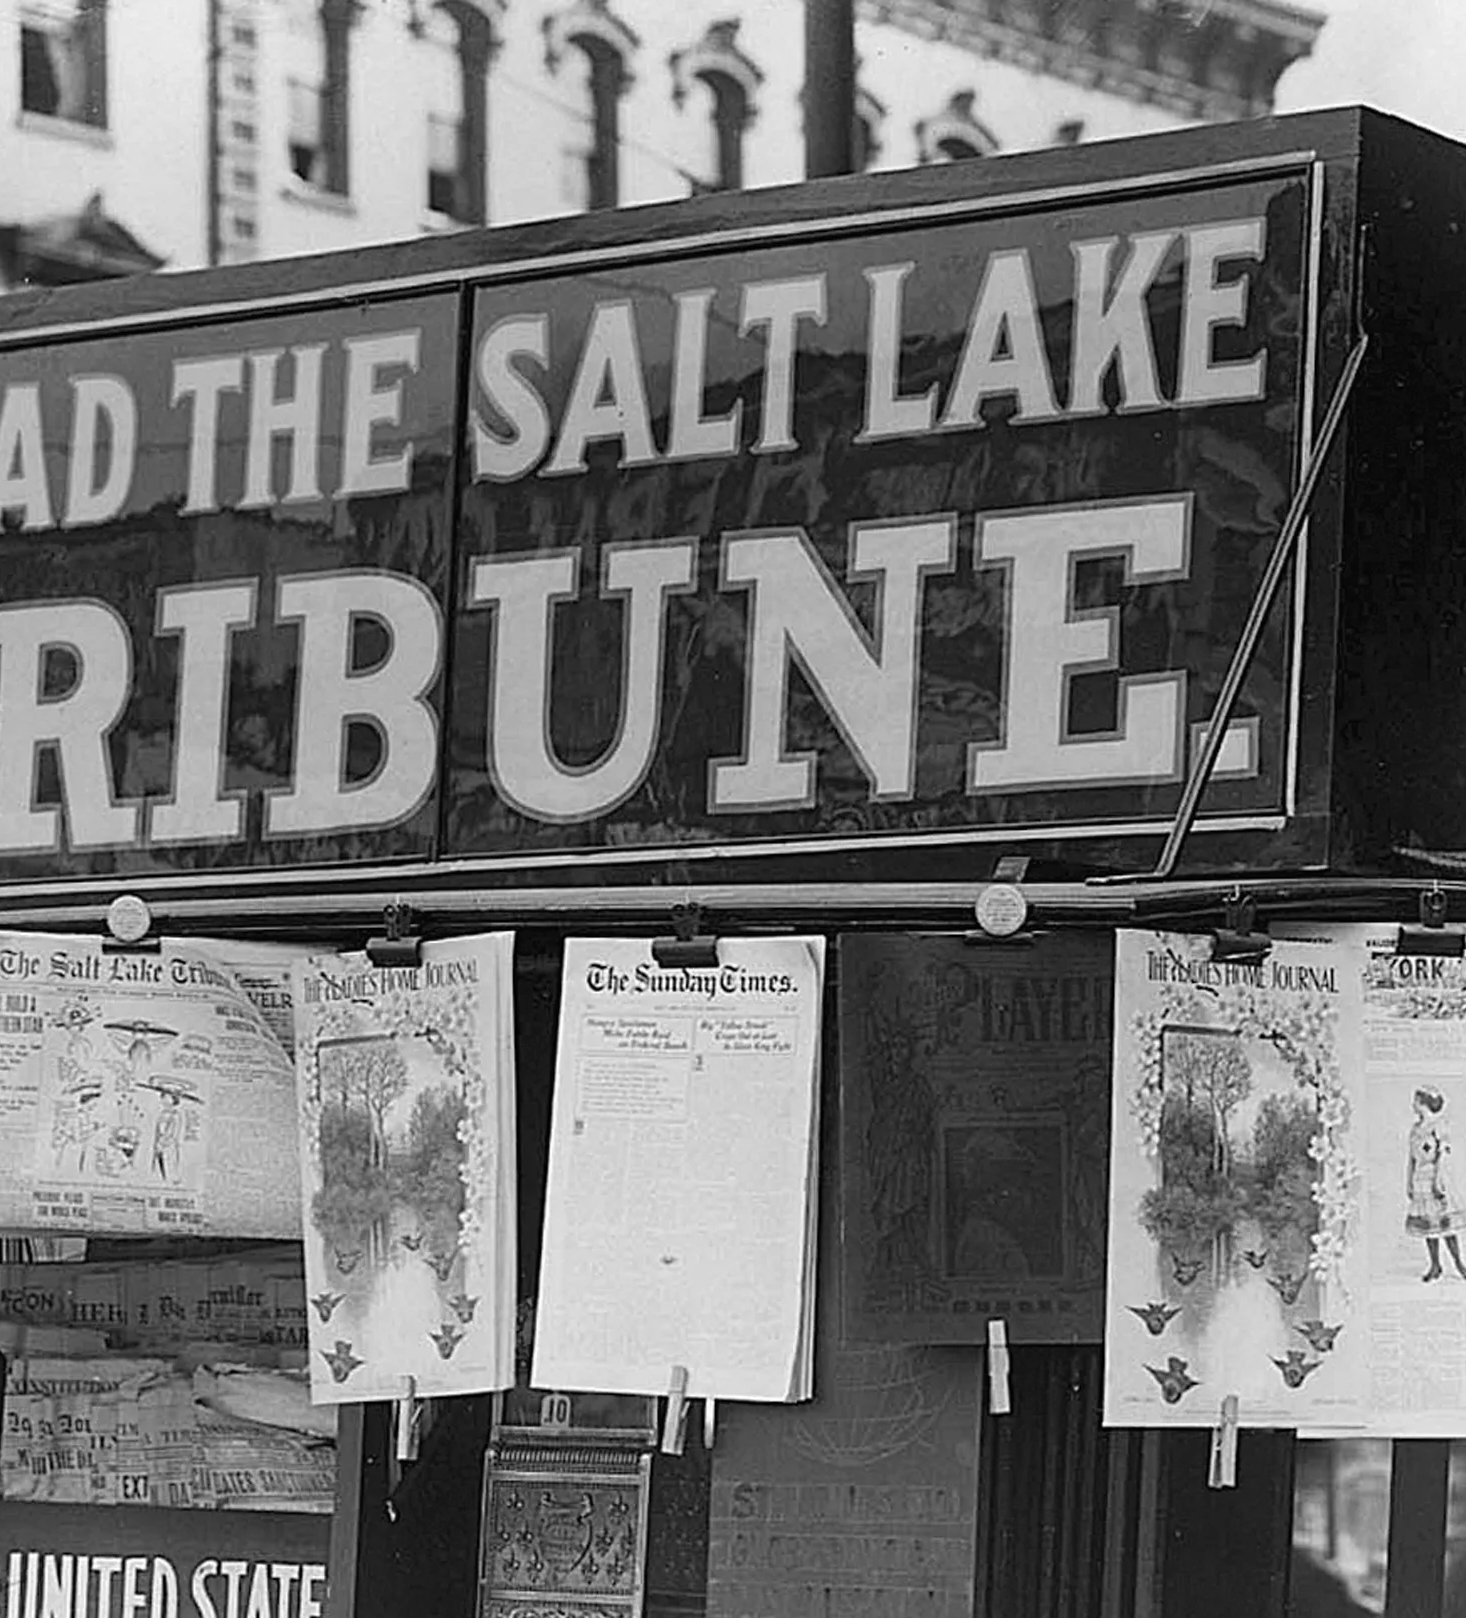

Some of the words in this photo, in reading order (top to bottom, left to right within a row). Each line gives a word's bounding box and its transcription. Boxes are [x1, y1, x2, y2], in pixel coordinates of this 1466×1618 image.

[169, 330, 423, 518] THE
[471, 277, 829, 485] SALT
[854, 218, 1269, 444] LAKE
[48, 950, 101, 982] Salt
[107, 956, 163, 984] Lake
[425, 958, 480, 985] JOURNAL
[586, 963, 629, 996] The
[634, 963, 718, 1001] Sunday
[719, 964, 799, 994] Times.
[1271, 961, 1340, 994] JOURNAL
